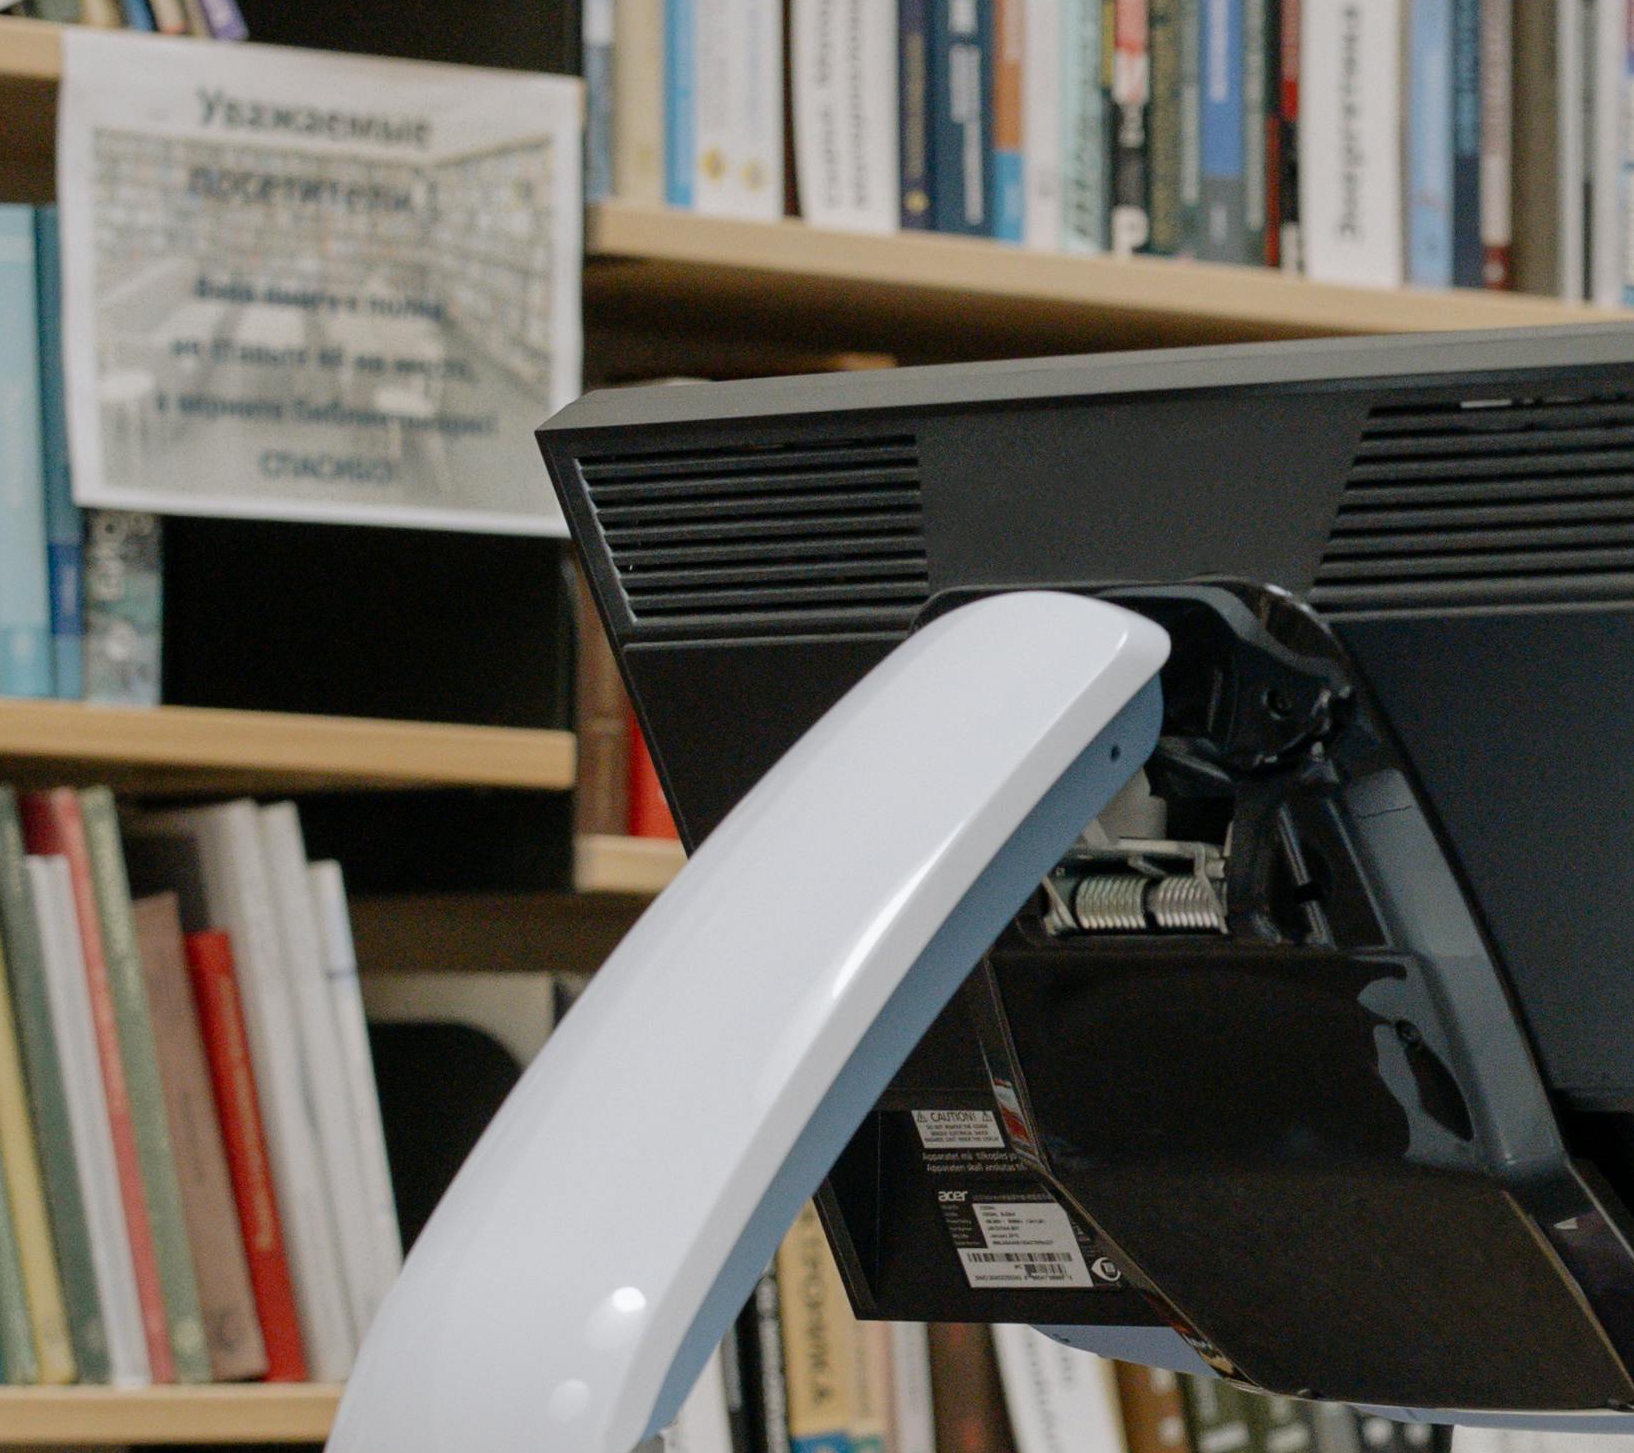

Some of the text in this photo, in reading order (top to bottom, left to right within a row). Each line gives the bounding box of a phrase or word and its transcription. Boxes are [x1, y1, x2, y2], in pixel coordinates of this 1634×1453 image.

[197, 86, 432, 146] Уважаемые
[930, 1112, 976, 1122] CAUTION!
[938, 1191, 968, 1202] acer
